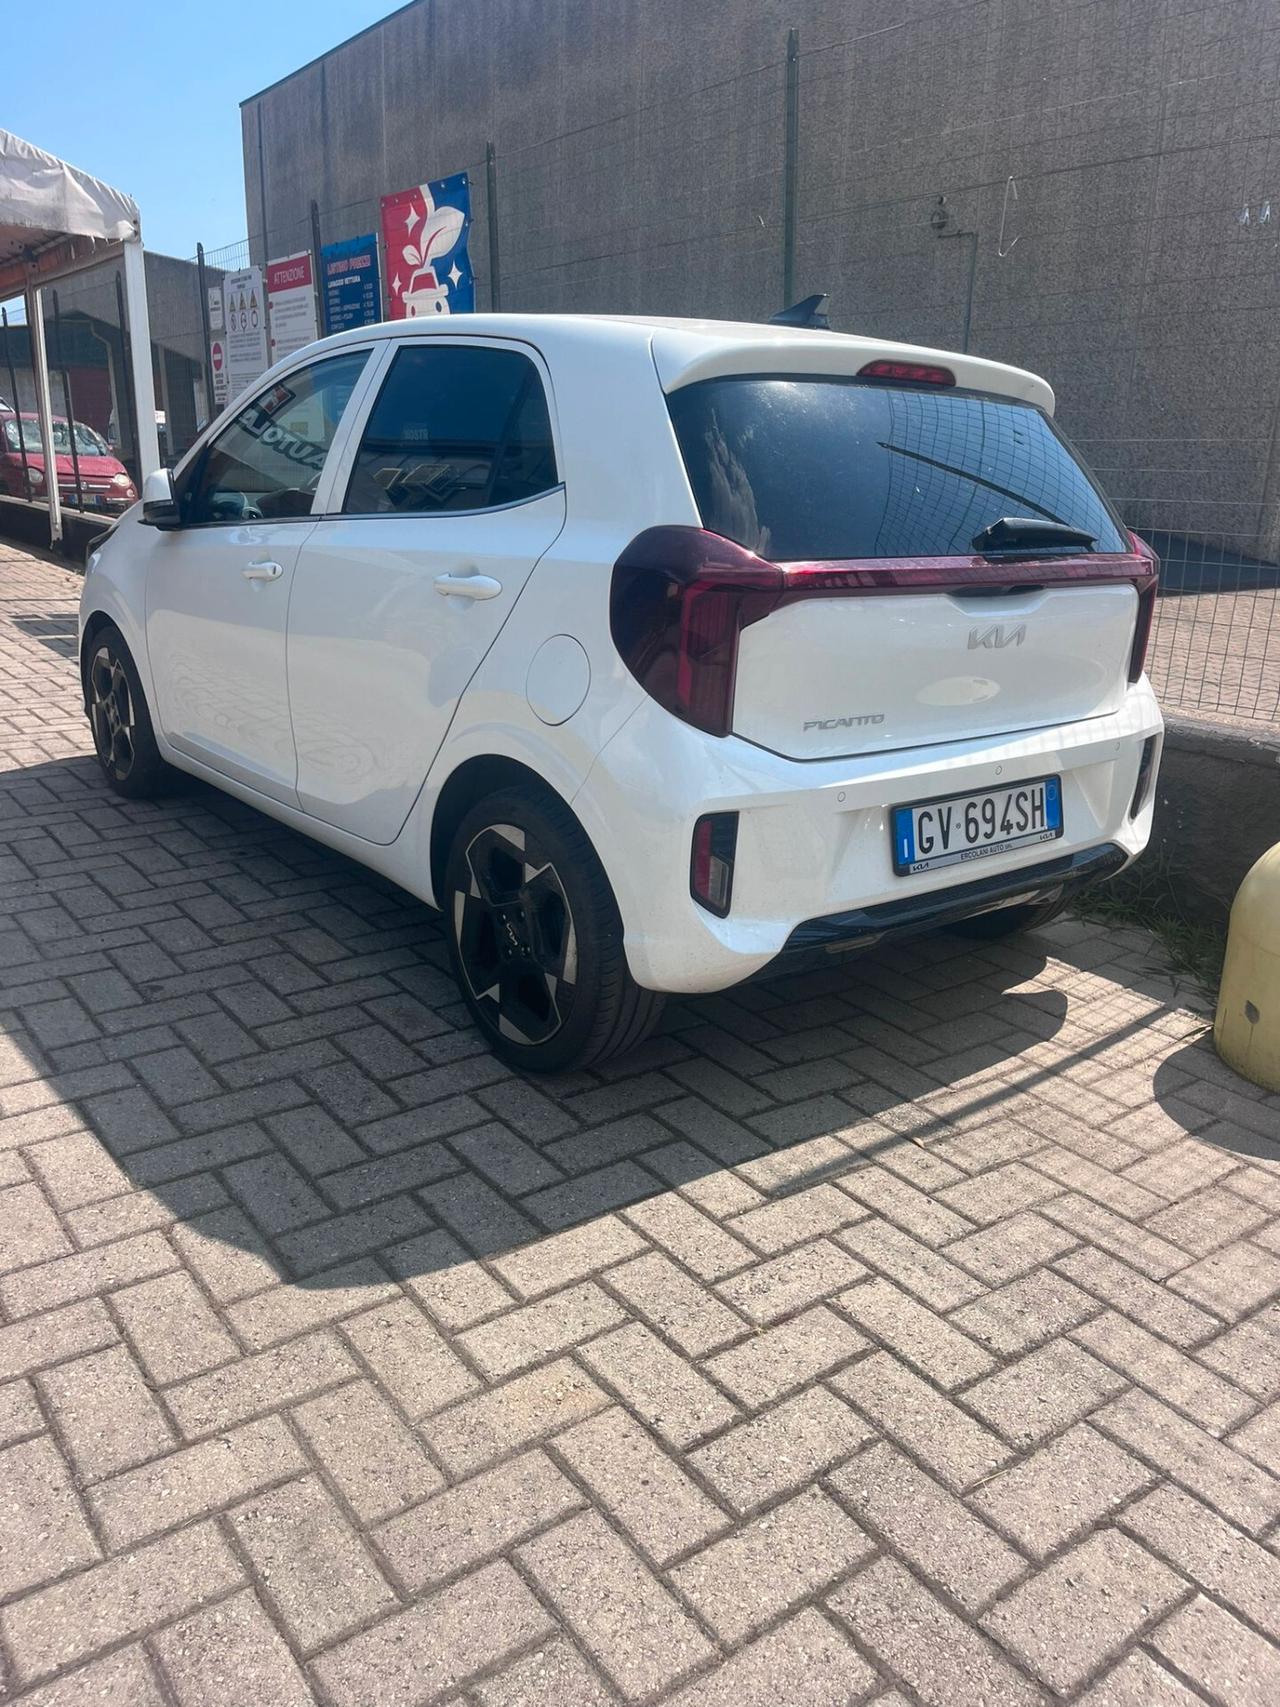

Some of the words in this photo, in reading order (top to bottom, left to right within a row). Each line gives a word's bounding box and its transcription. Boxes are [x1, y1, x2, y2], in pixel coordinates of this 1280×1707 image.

[273, 265, 305, 285] ATTENZIONE
[967, 623, 1027, 650] KIA
[803, 713, 885, 732] PICANTO
[918, 806, 953, 854] GV
[965, 787, 1045, 844] 694SH
[960, 848, 988, 860] ERCOLANI
[989, 844, 1004, 854] AUTO
[912, 862, 930, 871] KIA
